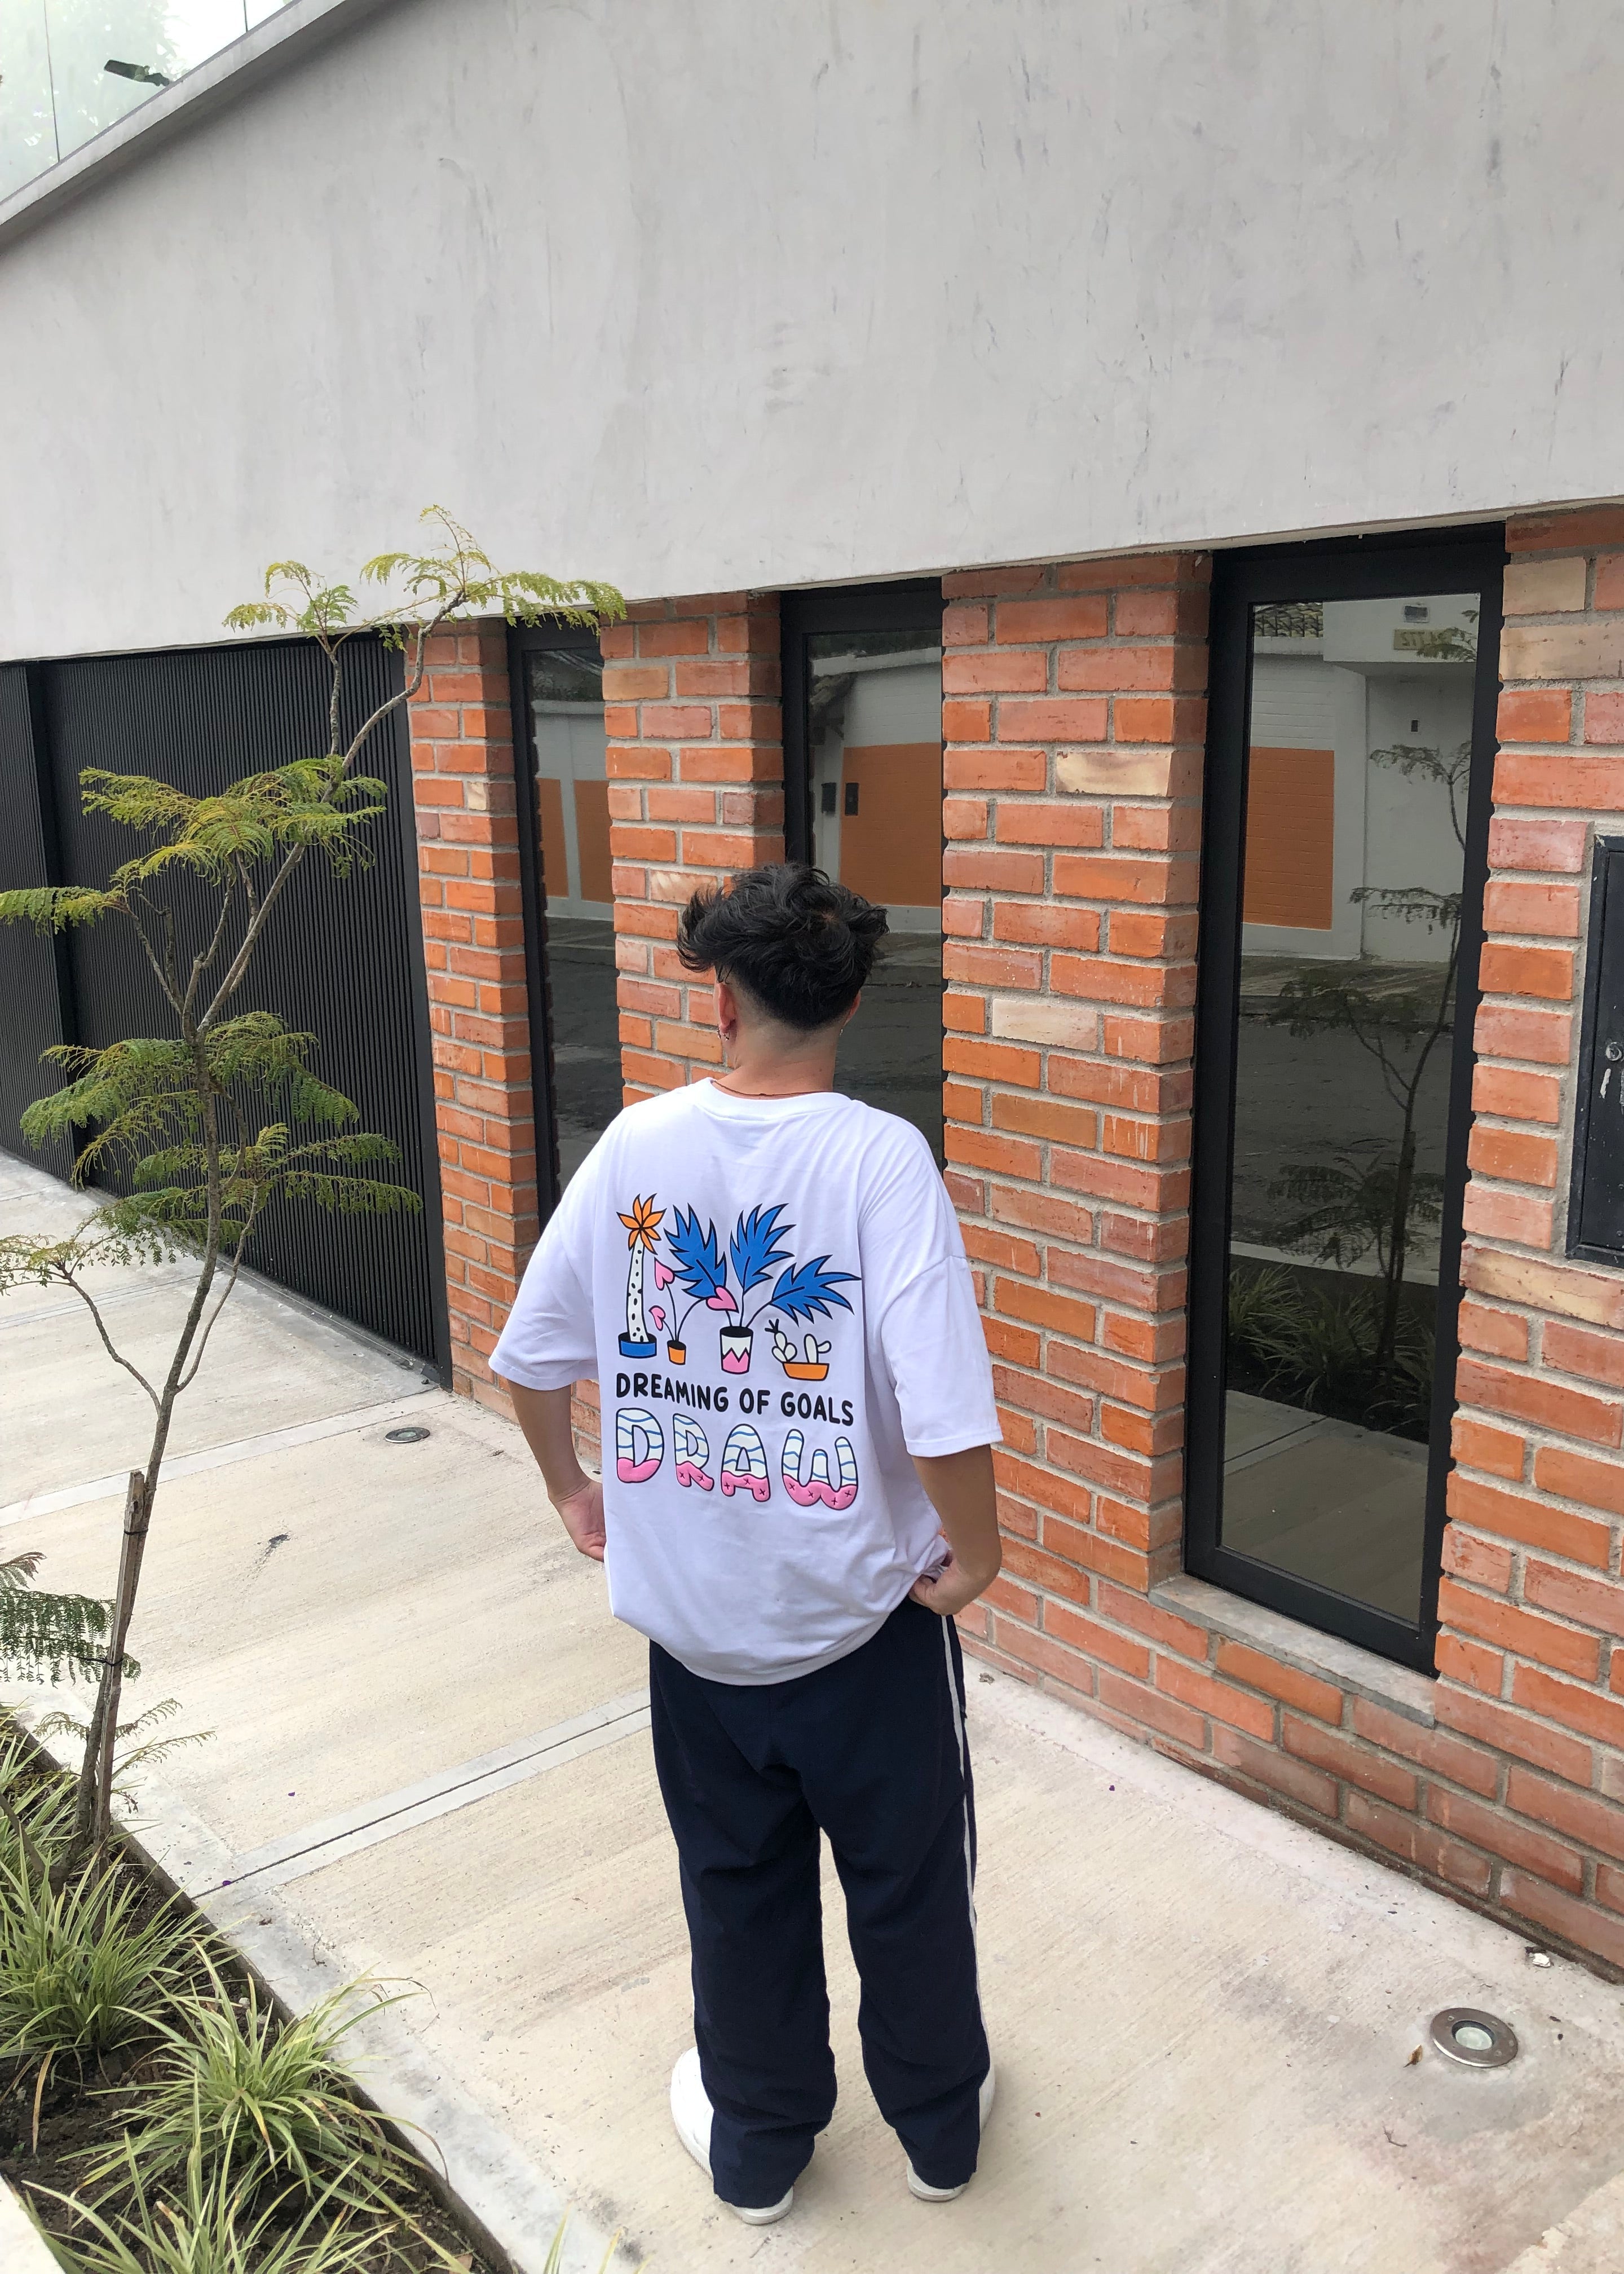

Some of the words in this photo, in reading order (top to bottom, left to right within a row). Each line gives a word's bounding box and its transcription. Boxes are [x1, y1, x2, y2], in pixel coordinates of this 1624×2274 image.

[616, 1373, 729, 1412] DREAMING
[739, 1389, 771, 1414] OF
[780, 1392, 854, 1426] GOALS
[616, 1408, 858, 1510] DRAW
